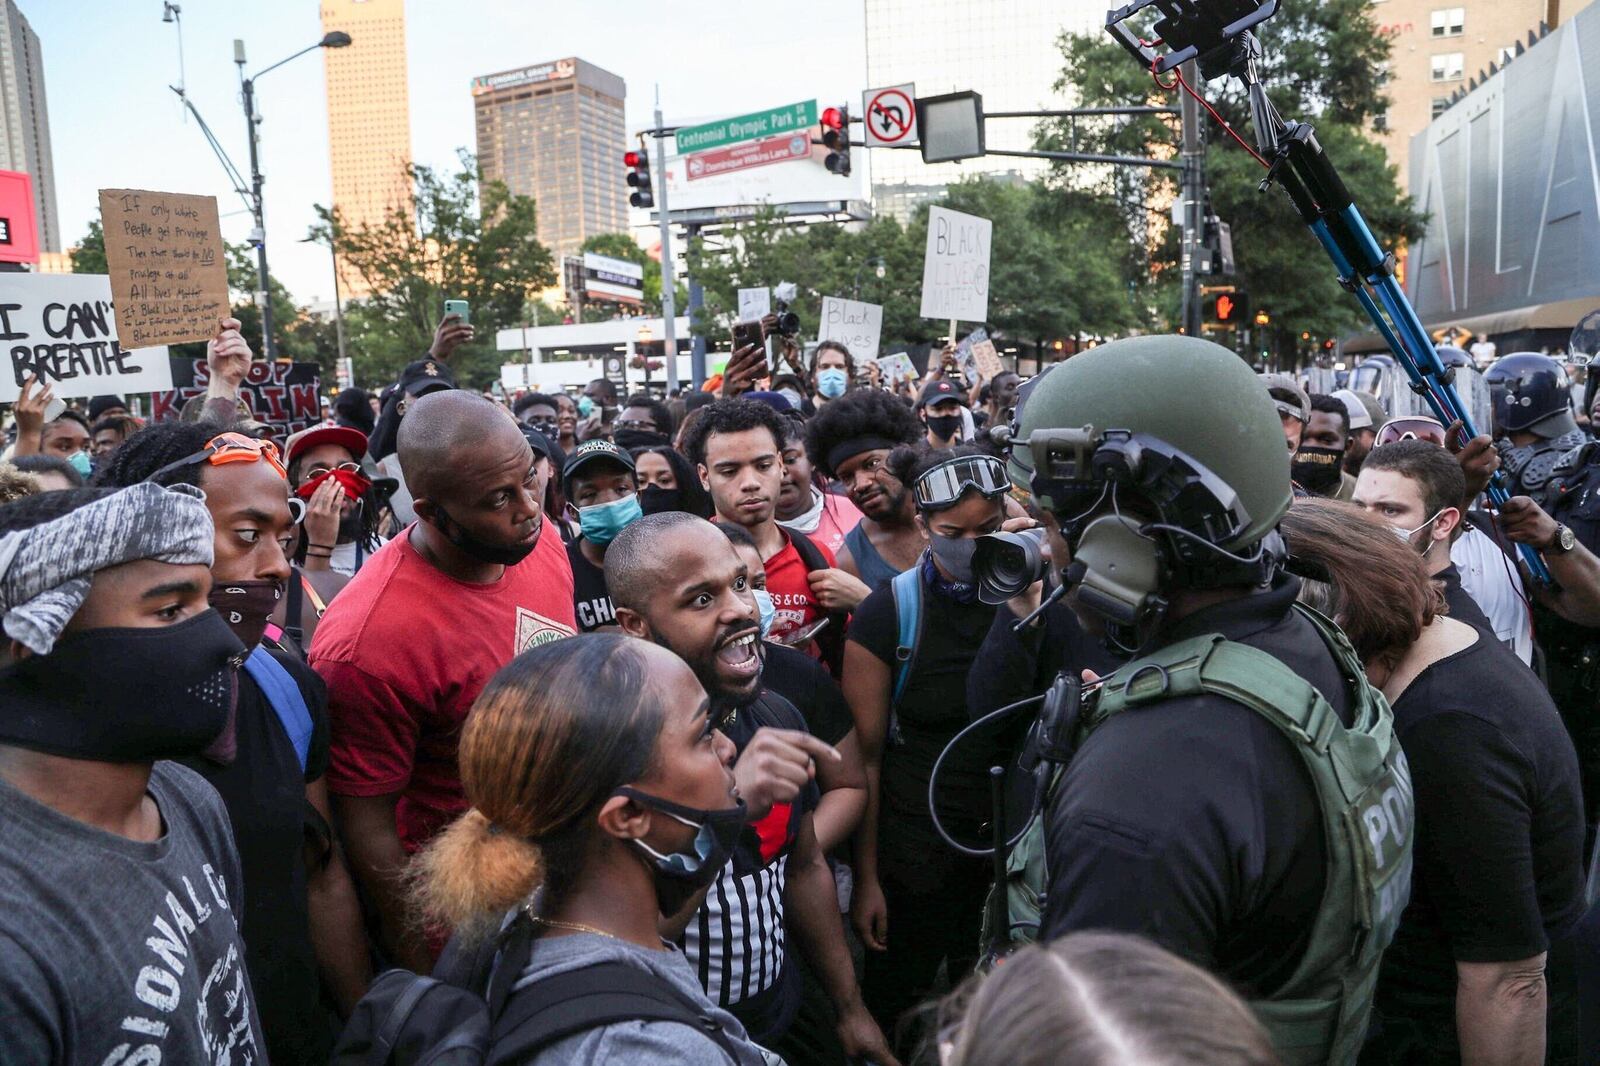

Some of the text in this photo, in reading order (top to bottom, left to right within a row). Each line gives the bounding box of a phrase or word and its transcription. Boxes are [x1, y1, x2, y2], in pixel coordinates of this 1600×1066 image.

[679, 112, 793, 147] Centennial Olympic Park
[121, 194, 140, 212] If
[151, 201, 170, 223] only
[124, 221, 152, 237] People
[158, 226, 170, 241] get
[937, 216, 983, 256] BLACK
[201, 249, 215, 261] NO
[165, 270, 174, 279] at
[130, 284, 148, 300] All
[0, 301, 115, 340] I CAN'
[122, 304, 136, 319] If
[140, 303, 159, 316] Black
[828, 300, 871, 325] Black
[11, 341, 142, 387] BREATHE
[193, 358, 292, 388] SOP
[784, 594, 792, 605] &
[778, 612, 801, 621] ETED
[528, 632, 556, 648] ENNY
